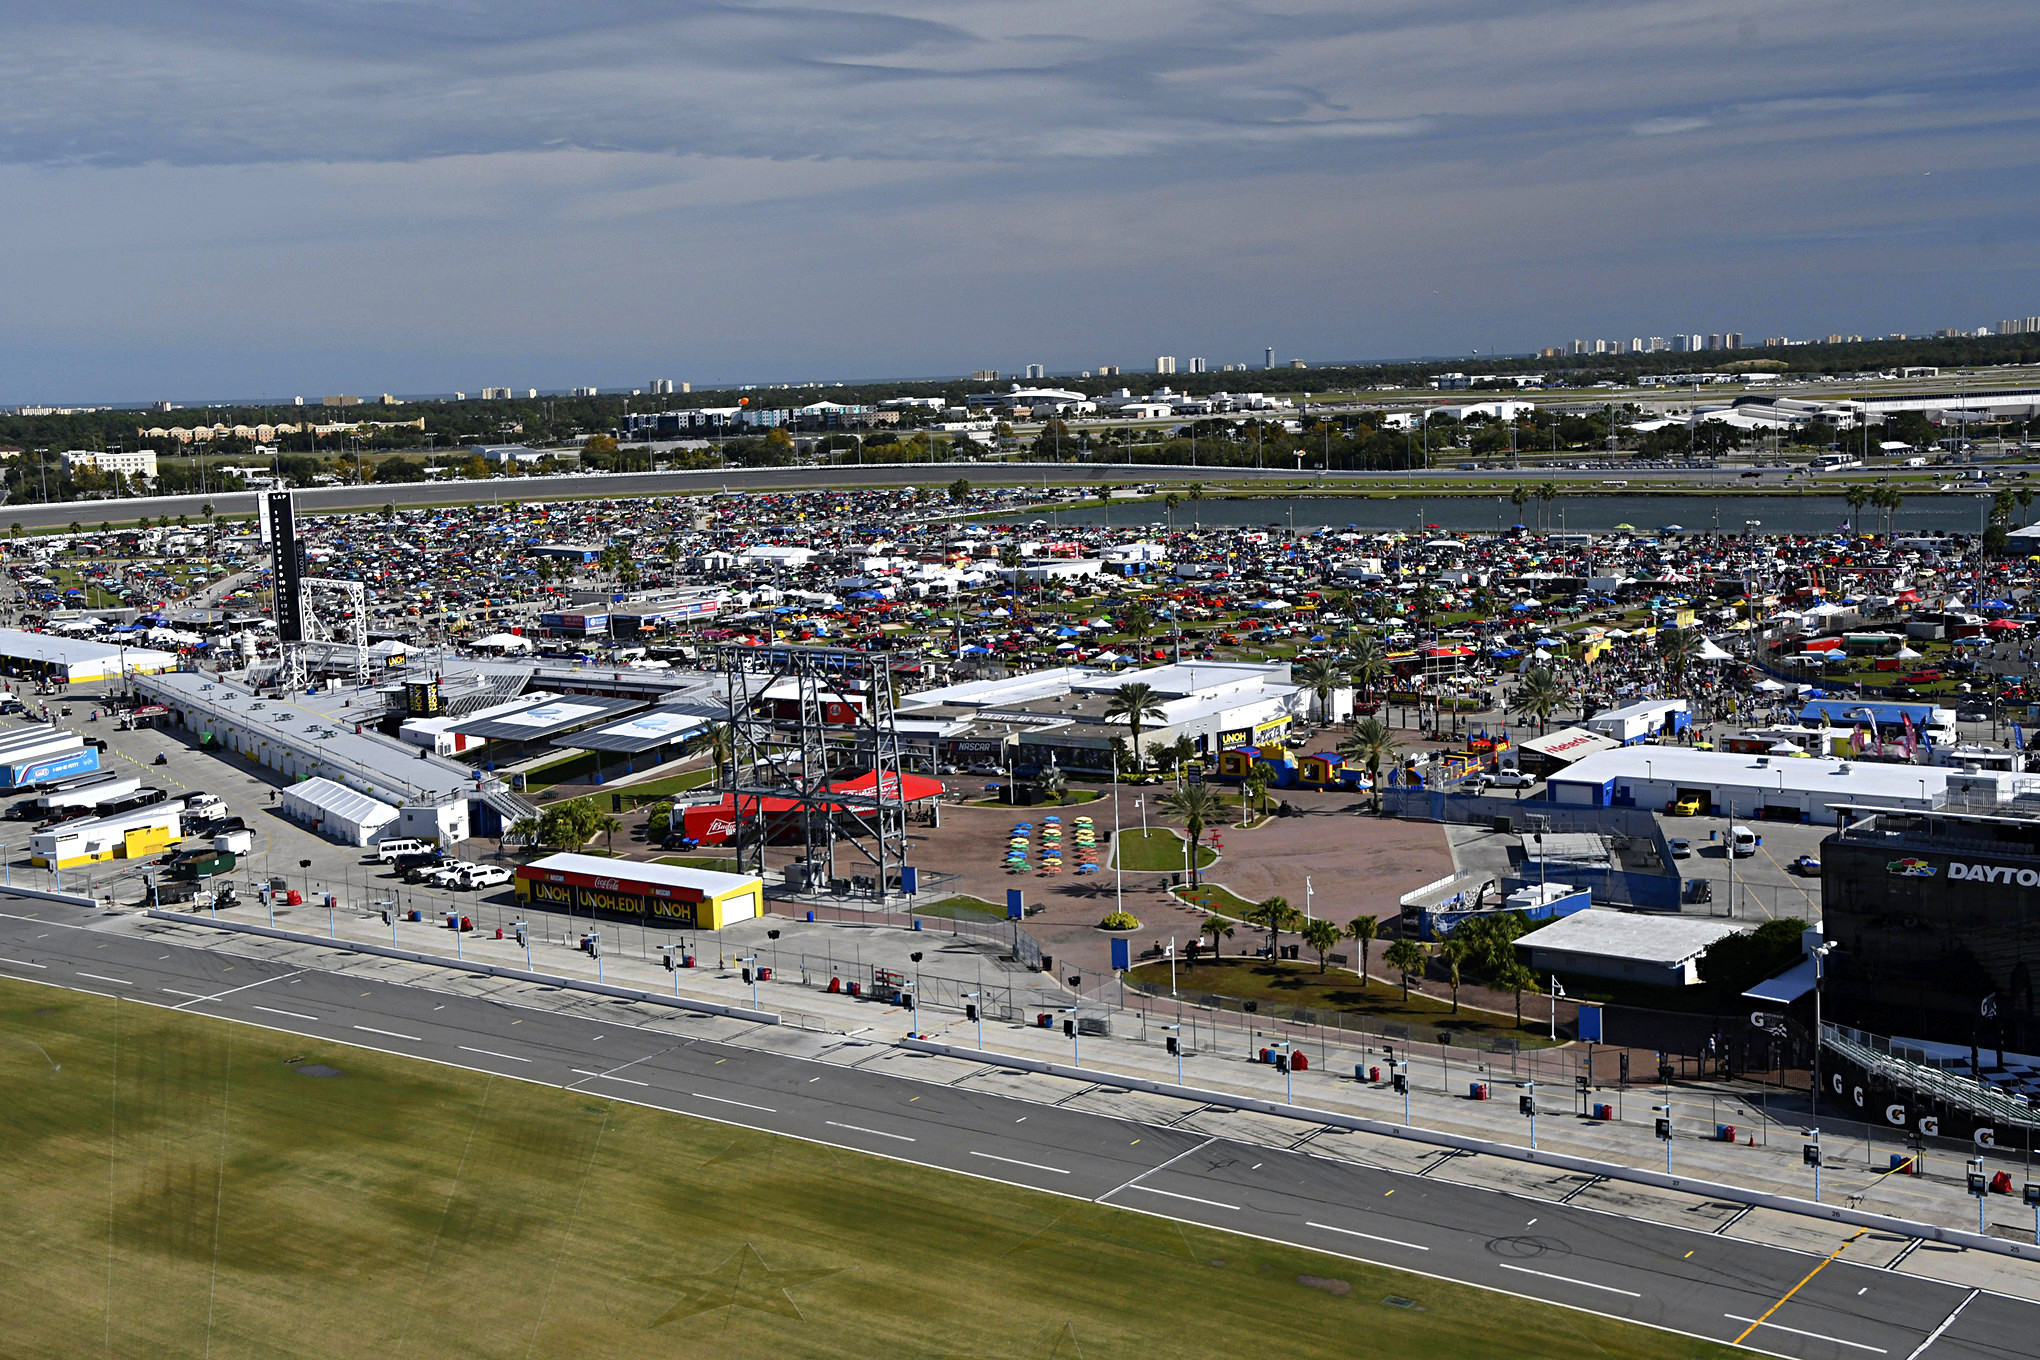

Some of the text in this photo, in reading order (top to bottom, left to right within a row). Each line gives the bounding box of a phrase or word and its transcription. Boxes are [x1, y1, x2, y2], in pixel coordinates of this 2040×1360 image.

[388, 656, 405, 666] UNOH
[414, 685, 422, 711] UNOH
[958, 742, 990, 751] NASCAR
[1222, 732, 1246, 743] UNOH
[1948, 862, 2040, 888] DAYTO
[536, 884, 570, 902] UNOH
[580, 890, 644, 912] UNOH.EDU
[653, 900, 690, 920] UNOH
[1750, 1012, 1764, 1027] G
[1832, 1073, 1843, 1094] G
[1854, 1086, 1863, 1107] G
[1885, 1104, 1905, 1124] G
[1919, 1116, 1938, 1136] G
[1973, 1127, 1994, 1148] G
